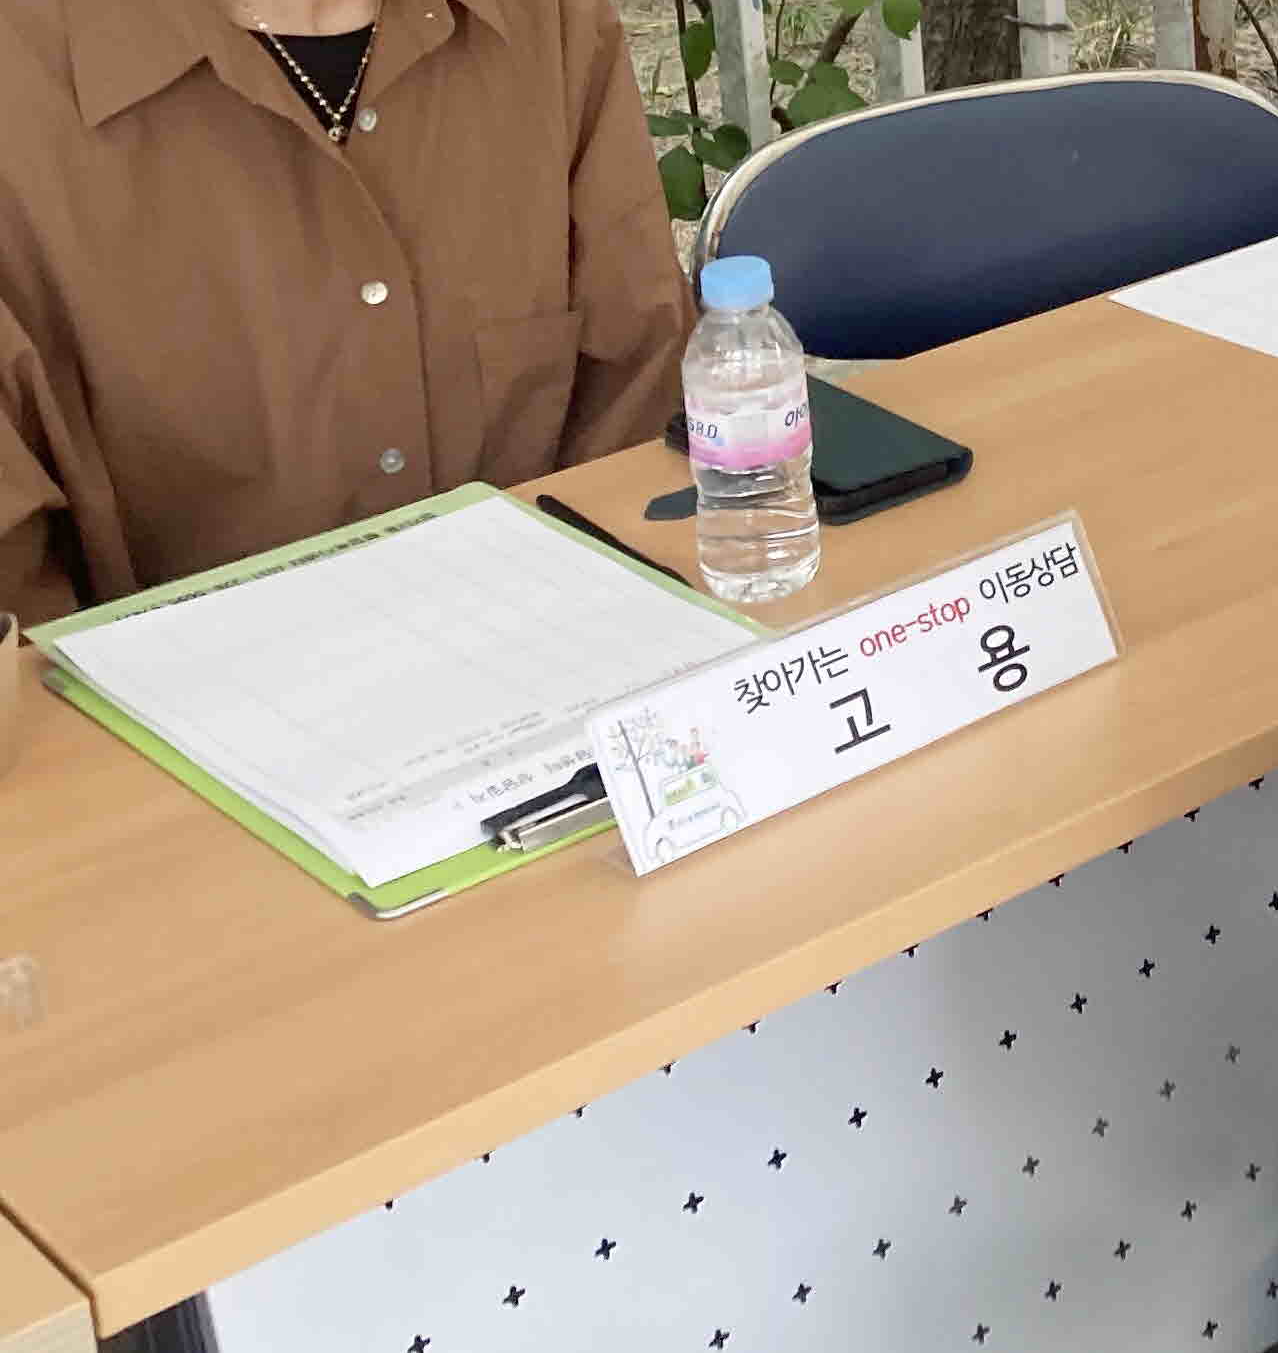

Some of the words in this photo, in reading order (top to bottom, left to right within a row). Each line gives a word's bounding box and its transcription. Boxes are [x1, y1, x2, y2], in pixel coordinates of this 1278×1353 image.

[732, 642, 850, 715] 찾아가는
[858, 594, 972, 659] one-stop
[977, 540, 1082, 604] 이동상담
[828, 688, 892, 755] 고
[976, 623, 1031, 693] 용
